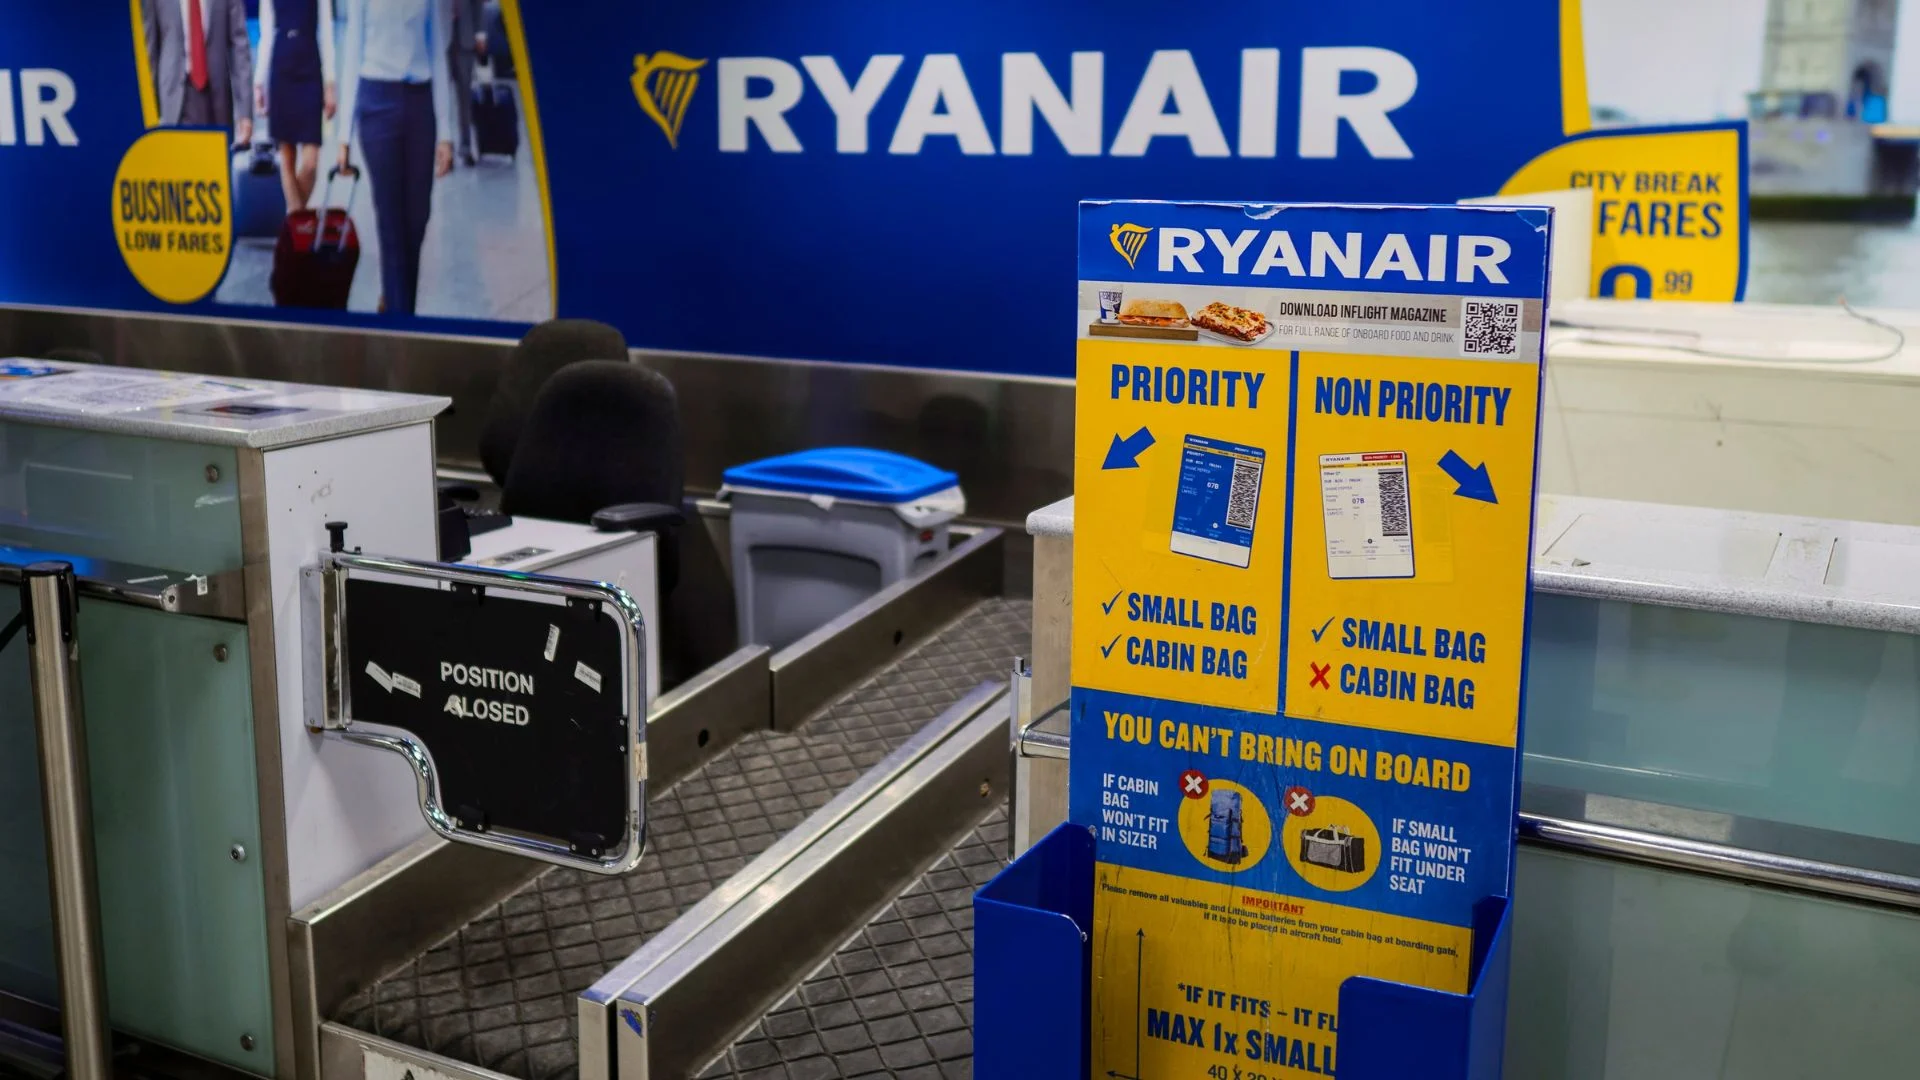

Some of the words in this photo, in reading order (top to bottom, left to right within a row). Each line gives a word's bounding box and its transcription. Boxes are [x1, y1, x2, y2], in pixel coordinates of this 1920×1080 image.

[717, 47, 1419, 160] RYANAIR
[1570, 171, 1626, 192] CITY
[1635, 172, 1721, 194] BREAK
[121, 179, 222, 225] BUSINESS
[1598, 201, 1723, 238] FARES
[124, 230, 162, 252] LOW
[167, 231, 223, 254] FARES
[1158, 227, 1512, 284] RYANAIR
[1280, 302, 1338, 318] DOWNLOAD
[1340, 305, 1389, 320] INFLIGHT
[1390, 307, 1447, 323] MAGAZINE
[1279, 325, 1293, 335] FOR
[1294, 326, 1312, 336] FULL
[1314, 327, 1340, 338] RANGE
[1341, 328, 1351, 338] OF
[1352, 328, 1390, 340] ONBOARD
[1391, 331, 1411, 341] FOOD
[1412, 332, 1430, 342] AND
[1431, 332, 1455, 343] DRINK
[1111, 364, 1265, 409] PRIORITY
[1315, 376, 1372, 416] NON
[1378, 380, 1512, 426] PRIORITY
[1127, 592, 1203, 629] SMALL
[1211, 602, 1257, 635] BAG
[1126, 636, 1195, 672] CABIN
[1201, 646, 1248, 679] BAG
[1342, 617, 1426, 656] SMALL
[1434, 628, 1486, 663] BAG
[440, 661, 534, 696] POSITION
[1340, 663, 1416, 702] CABIN
[1424, 674, 1475, 709] BAG
[1103, 711, 1152, 745] YOU
[1239, 731, 1322, 772] BRING
[1329, 744, 1368, 778] ON
[1375, 751, 1471, 792] BOARD
[1103, 772, 1116, 788] IF
[1118, 775, 1159, 796] CABIN
[1103, 790, 1129, 809] BAG
[1102, 826, 1116, 843] IN
[1118, 829, 1157, 850] SIZER
[1148, 816, 1169, 834] FIT
[1392, 818, 1406, 834] IF
[1408, 820, 1457, 843] SMALL
[1391, 836, 1420, 856] BAG
[1389, 874, 1425, 895] SEAT
[1390, 855, 1412, 873] FIT
[1415, 859, 1465, 883] UNDER
[1102, 883, 1128, 895] Please
[1128, 889, 1157, 900] remove
[1159, 894, 1169, 902] all
[1170, 896, 1209, 910] valuables
[1210, 902, 1226, 913] and
[1227, 905, 1258, 919] Lithium
[1259, 912, 1297, 926] batteries
[1298, 919, 1318, 930] from
[1319, 925, 1339, 937] your
[1340, 928, 1365, 940] cabin
[1366, 932, 1383, 945] bag
[1384, 936, 1395, 945] at
[1395, 937, 1435, 955] boarding
[1242, 895, 1305, 916] IMPORTANT
[1211, 914, 1218, 922] it
[1219, 915, 1227, 923] is
[1227, 916, 1237, 926] to
[1238, 918, 1250, 928] be
[1250, 921, 1278, 934] placed
[1280, 927, 1288, 935] in
[1289, 929, 1321, 942] aircraft
[1208, 989, 1226, 1009] IT
[1230, 994, 1271, 1018] FITS
[1294, 1007, 1313, 1027] IT
[1147, 1007, 1206, 1049] MAX
[1245, 1028, 1337, 1078] SMALL
